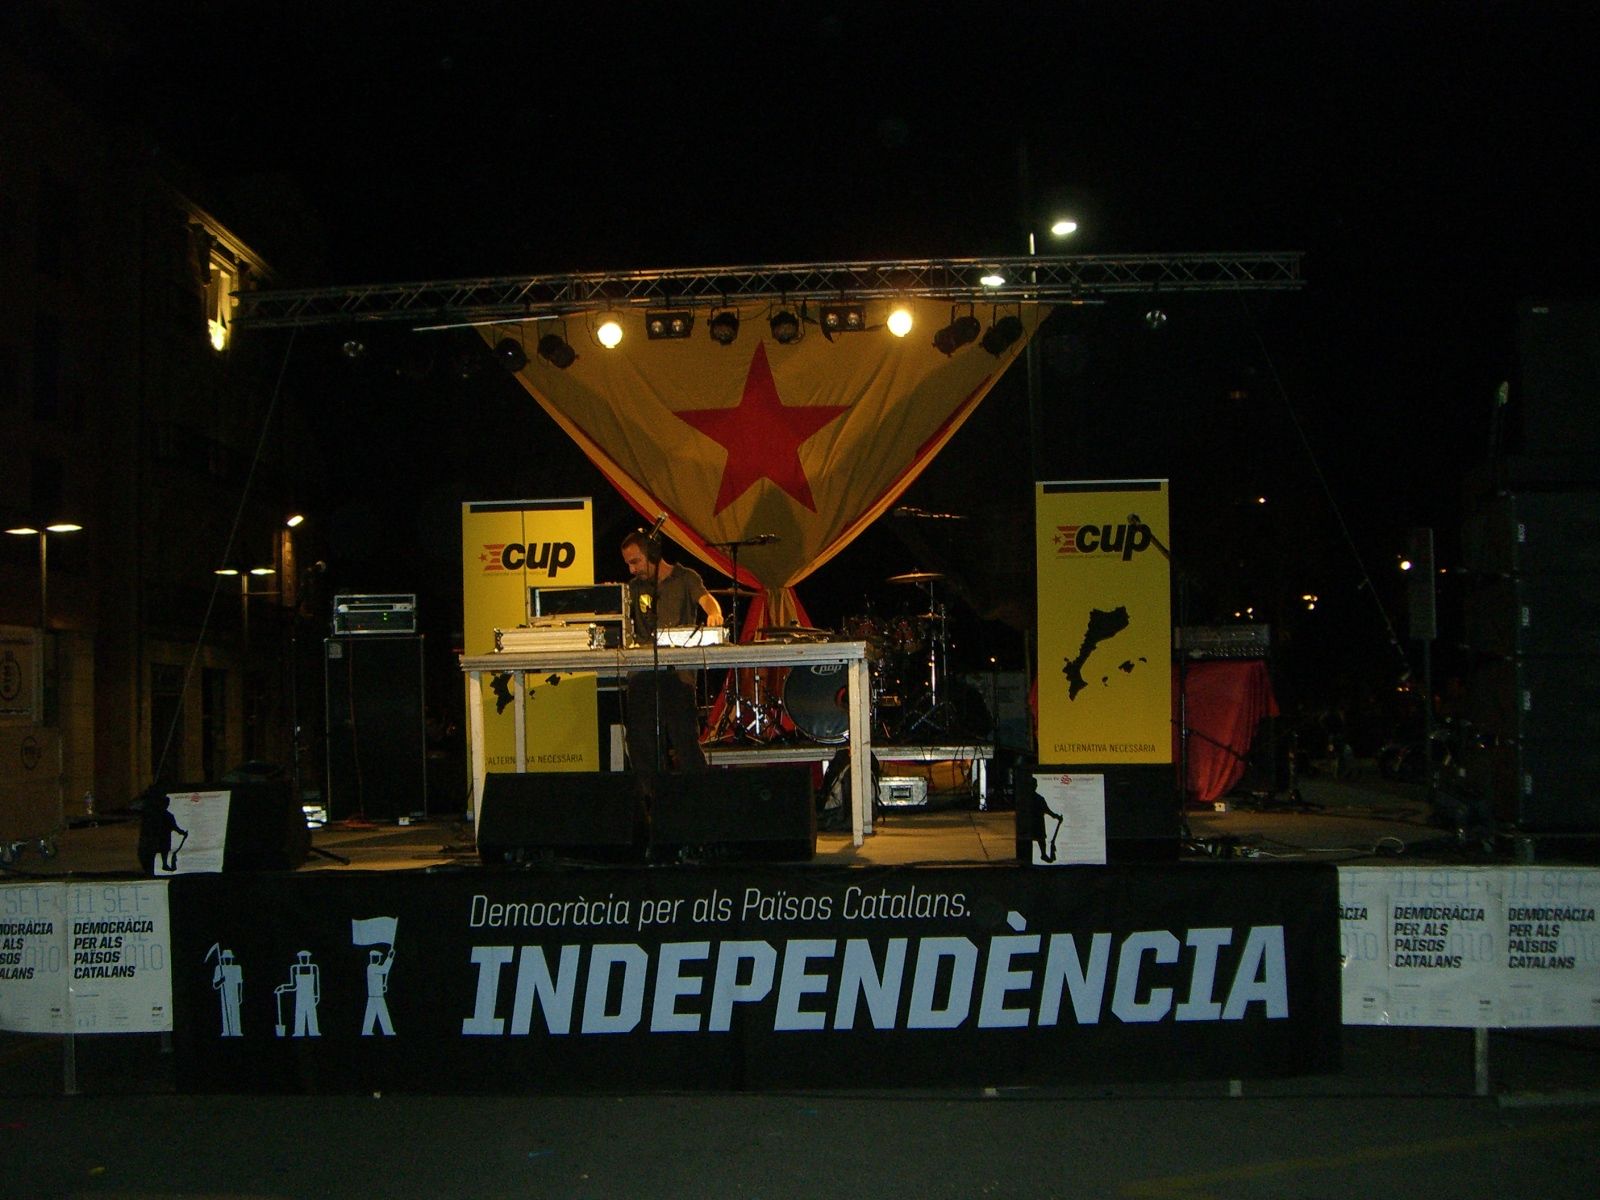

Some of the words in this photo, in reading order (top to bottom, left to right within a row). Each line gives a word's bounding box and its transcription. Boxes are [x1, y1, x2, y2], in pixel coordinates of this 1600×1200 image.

[1075, 524, 1152, 561] cup
[502, 541, 576, 578] cup
[469, 893, 630, 928] Democràcia
[637, 899, 685, 932] per
[692, 889, 732, 923] als
[741, 887, 833, 922] Països
[842, 885, 971, 920] Catalans.
[1393, 905, 1485, 921] DEMOCRÀCIA
[73, 918, 154, 935] DEMOCRÀCIA
[1394, 922, 1420, 936] PER
[1423, 923, 1449, 937] ALS
[1508, 924, 1533, 937] PER
[1536, 924, 1561, 938] ALS
[2, 937, 24, 951] ALS
[73, 937, 98, 950] PER
[99, 936, 123, 949] ALS
[1394, 936, 1446, 952] PAÏSOS
[73, 949, 121, 965] PAÏSOS
[1395, 955, 1463, 969] CATALANS
[1507, 955, 1576, 969] CATALANS
[73, 965, 136, 979] CATALANS
[461, 910, 1289, 1036] INDEPENDÈNCIA
